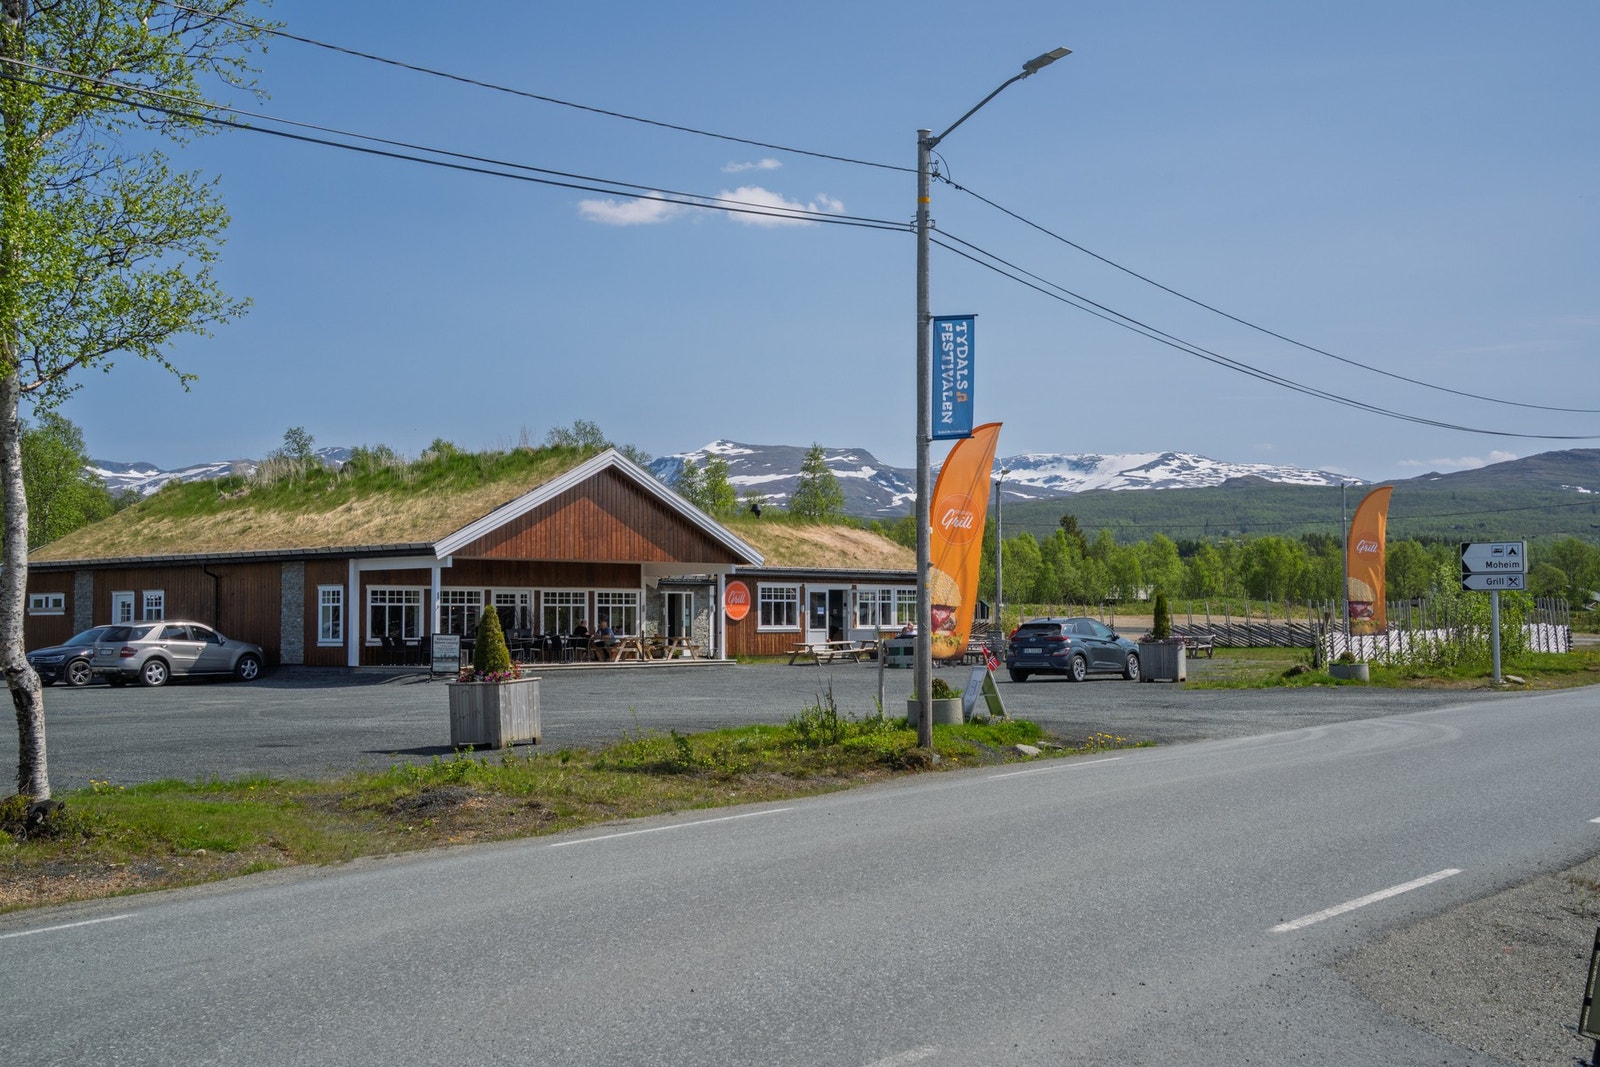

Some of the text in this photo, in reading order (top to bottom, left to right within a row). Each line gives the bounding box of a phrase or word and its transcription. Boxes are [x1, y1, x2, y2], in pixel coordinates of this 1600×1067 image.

[955, 321, 969, 390] TYDALS
[941, 322, 954, 424] FESTIVALEN
[941, 508, 973, 530] Grill
[1356, 539, 1378, 553] Grill
[1485, 561, 1520, 569] Moheim
[1486, 577, 1504, 586] Grill
